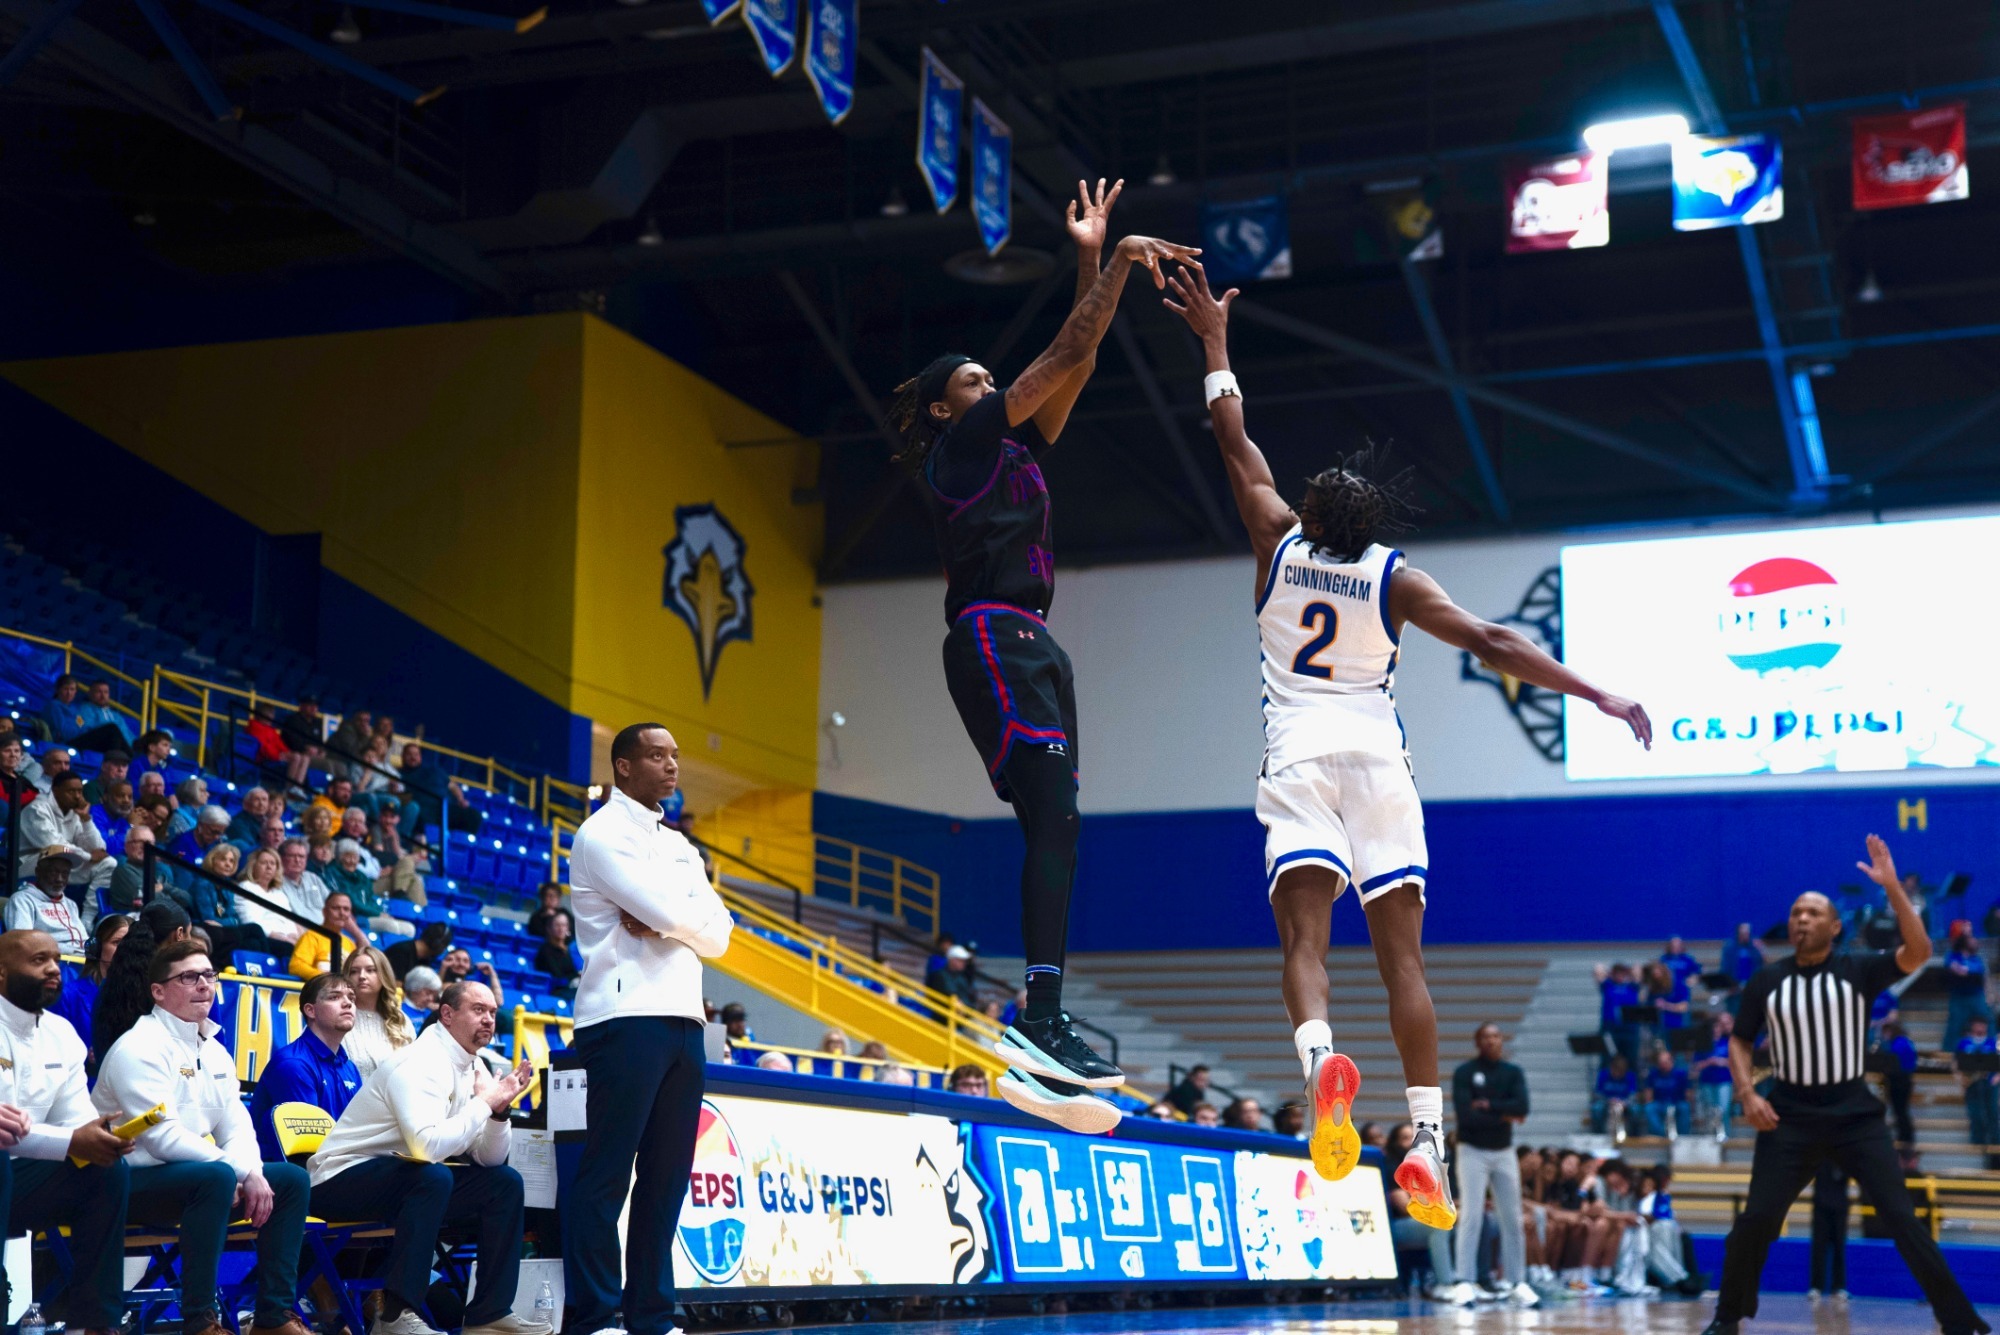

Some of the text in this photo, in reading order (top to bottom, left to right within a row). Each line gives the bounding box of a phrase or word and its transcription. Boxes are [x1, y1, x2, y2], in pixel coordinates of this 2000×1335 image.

[1284, 565, 1371, 602] CUNNINGHAM
[1291, 599, 1339, 681] 2
[1898, 798, 1928, 831] H
[283, 1118, 332, 1128] MOREHEAD
[294, 1127, 326, 1135] STATE
[689, 1172, 744, 1209] EPSI
[758, 1171, 893, 1217] G&J PEPSI
